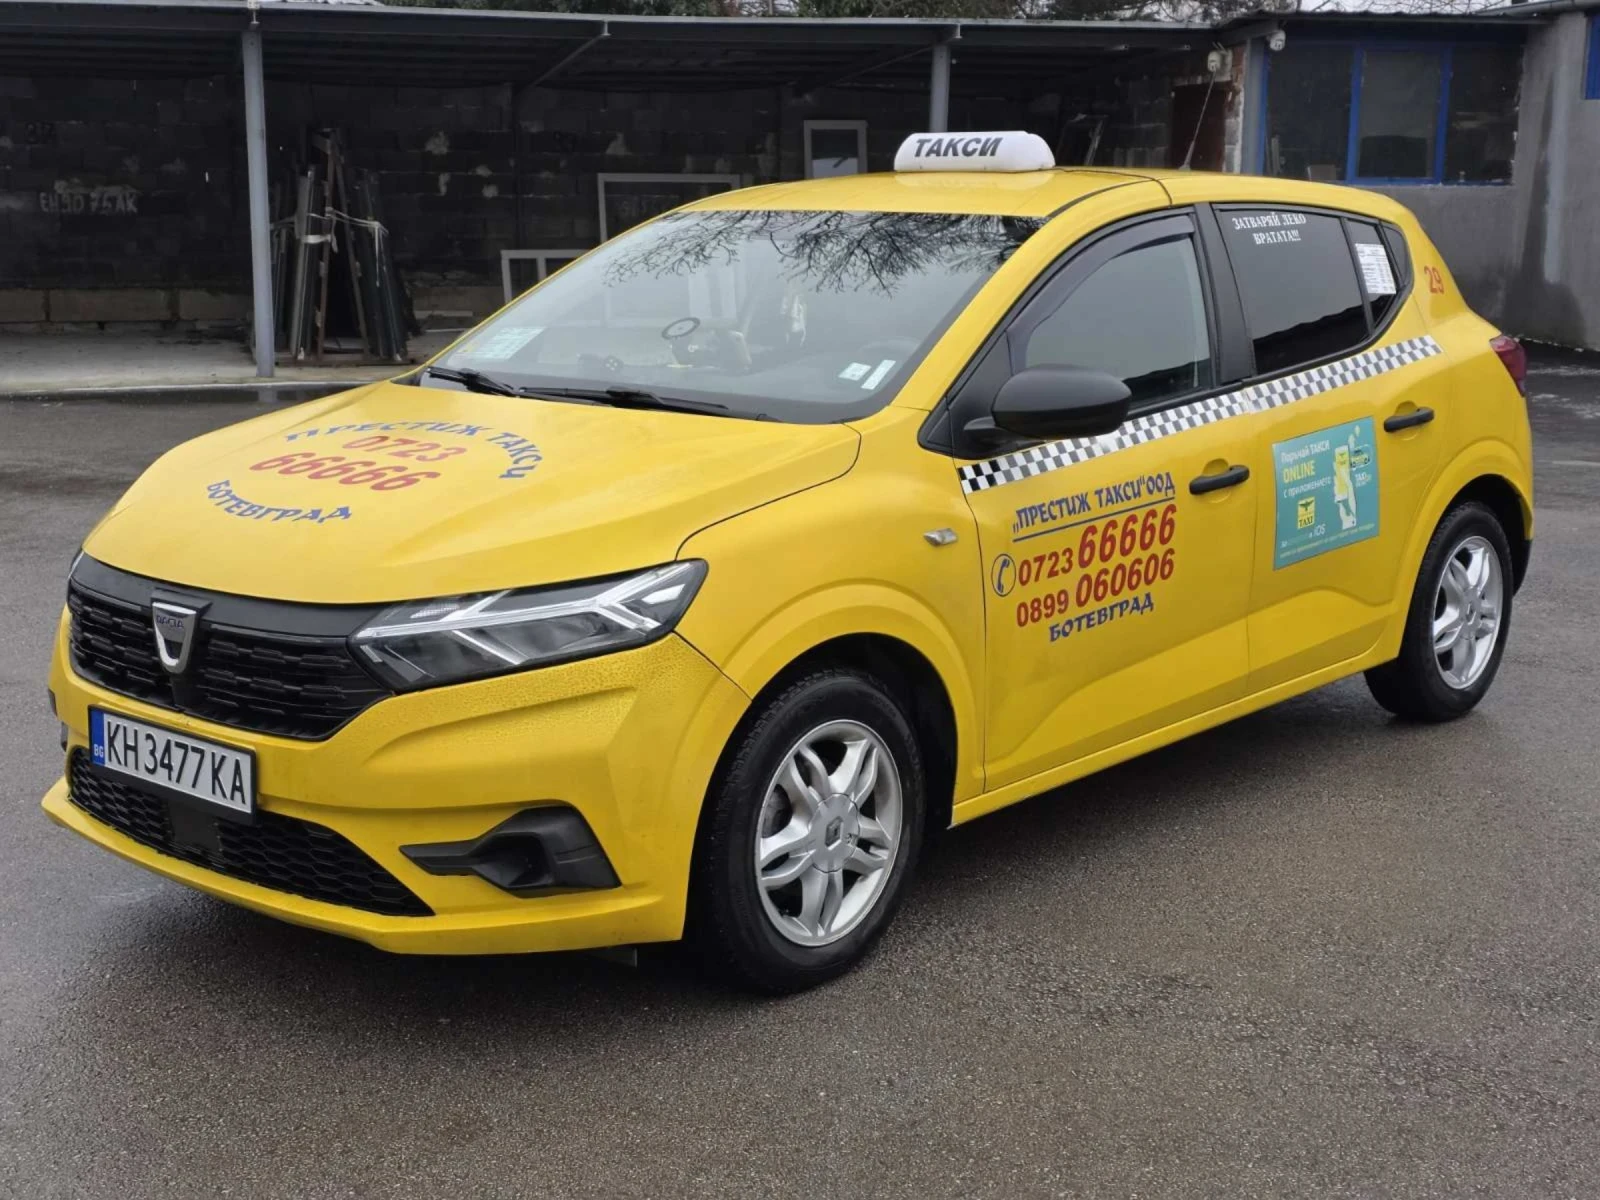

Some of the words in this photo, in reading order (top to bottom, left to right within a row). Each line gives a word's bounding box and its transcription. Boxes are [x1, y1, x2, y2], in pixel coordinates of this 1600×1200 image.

[914, 137, 1004, 158] ТАКСИ
[1232, 211, 1281, 230] ЗАТВАРЯЙ
[1424, 265, 1445, 295] 29
[342, 435, 468, 463] 0723
[487, 431, 544, 480] ТАКСИ
[249, 452, 441, 491] 66666
[1282, 460, 1316, 484] ONLINE
[206, 479, 353, 524] БОТЕВГРАД
[1298, 515, 1314, 527] TAXI
[1018, 547, 1073, 587] 0723
[1077, 504, 1177, 569] 66666
[1016, 589, 1069, 627] 0899
[1075, 548, 1175, 608] 060606
[1049, 592, 1154, 642] БОТЕВГРАД
[93, 743, 104, 758] BG
